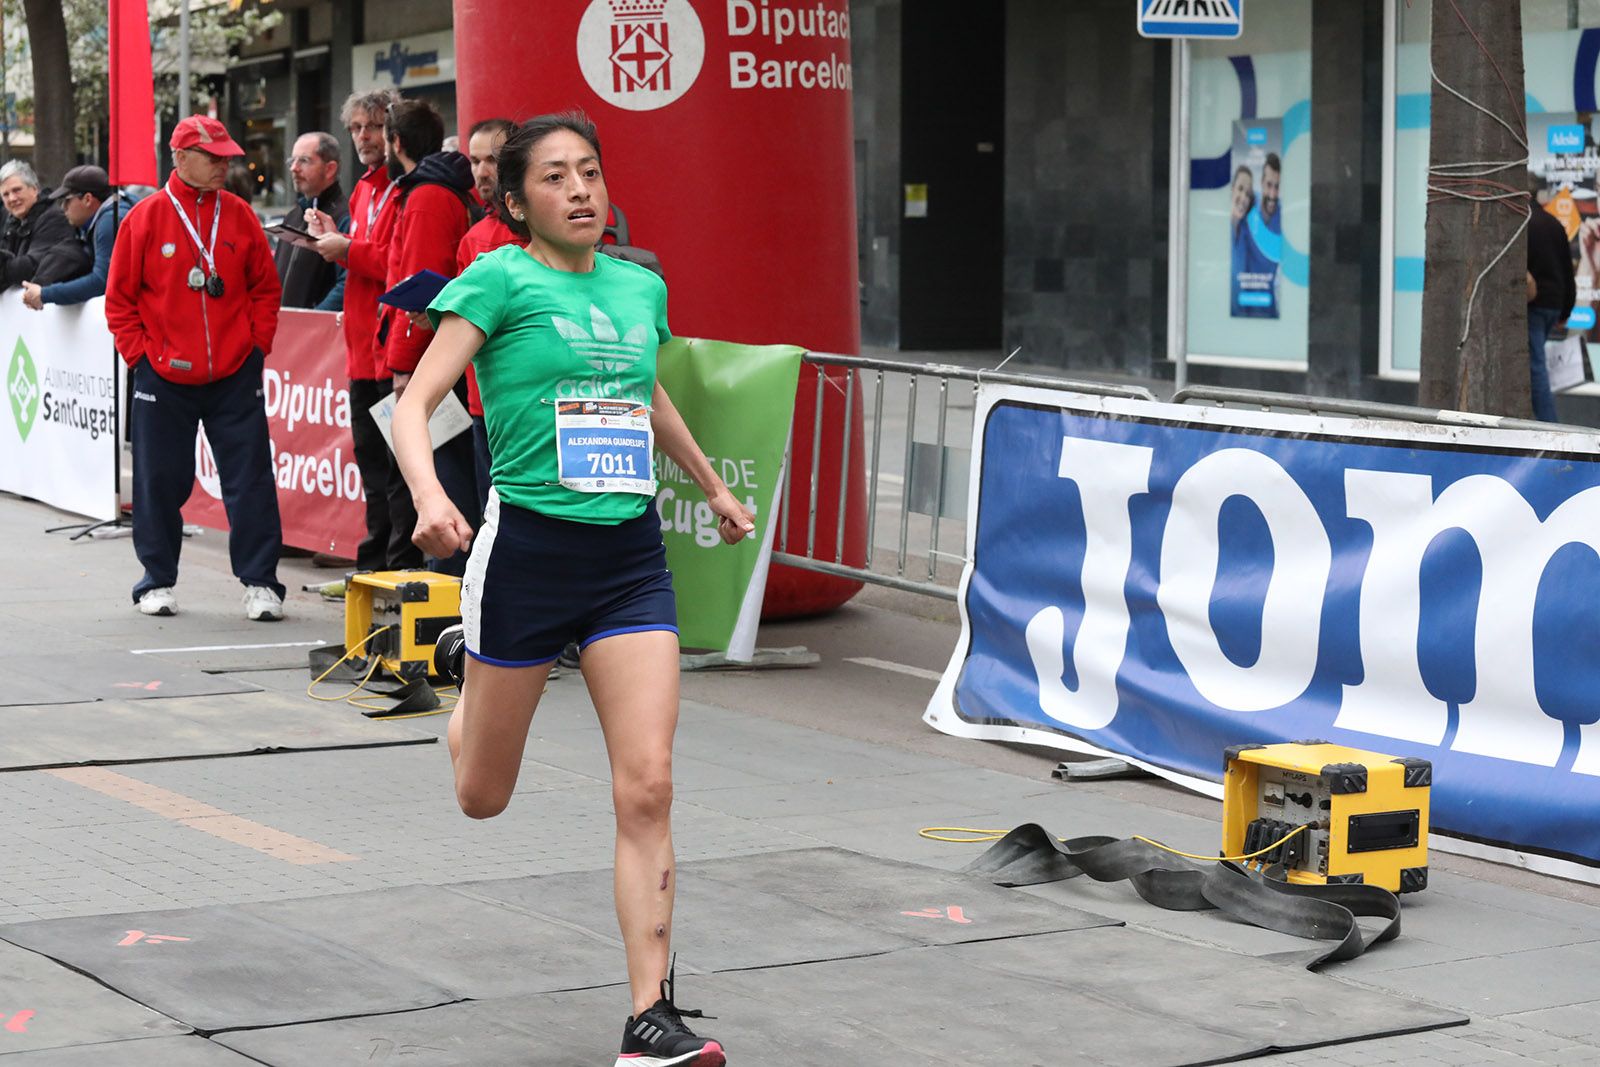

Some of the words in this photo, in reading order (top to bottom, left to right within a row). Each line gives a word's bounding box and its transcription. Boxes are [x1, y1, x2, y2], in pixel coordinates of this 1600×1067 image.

[44, 367, 95, 397] AJUNTAMENT
[567, 437, 612, 446] ALEXANDRA
[613, 439, 646, 449] GUADELUPE
[586, 452, 637, 475] 7011
[721, 458, 758, 488] DE
